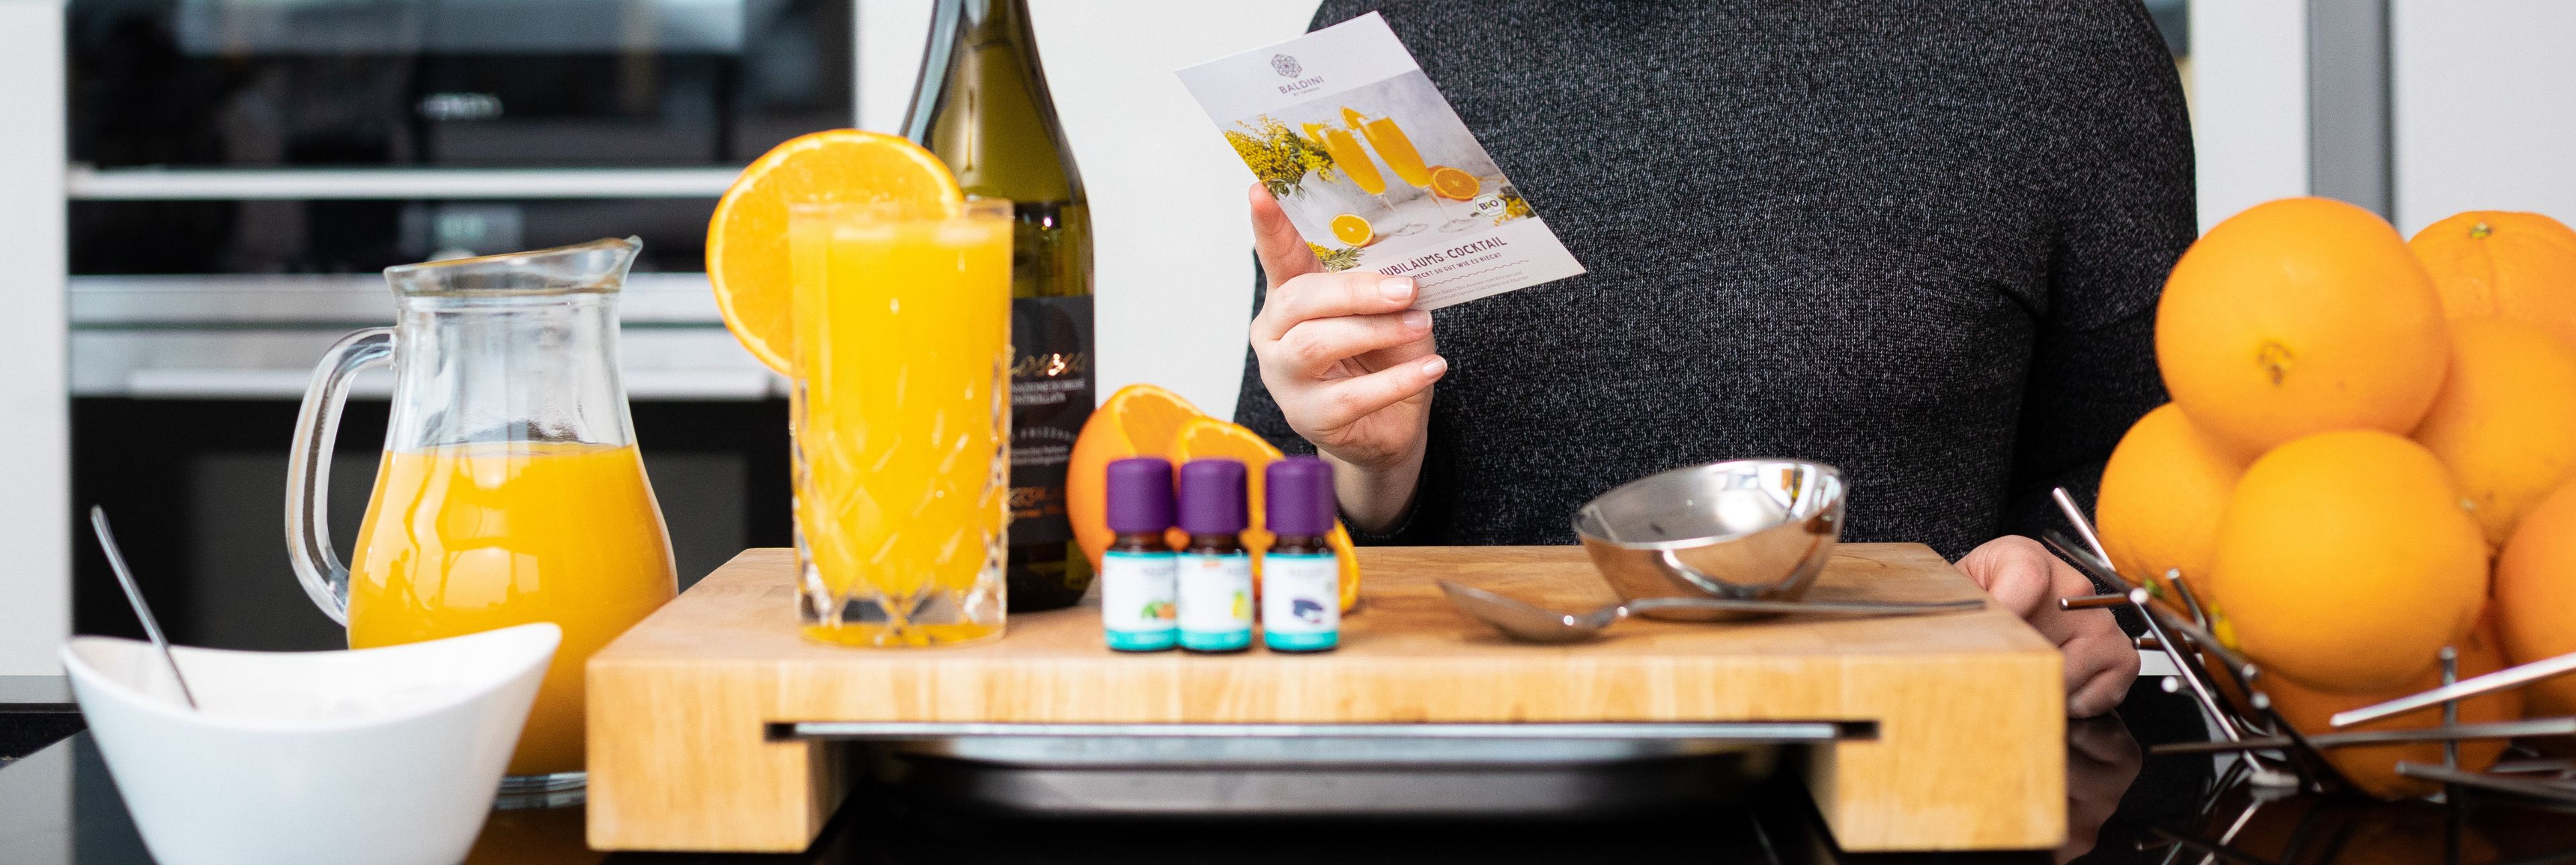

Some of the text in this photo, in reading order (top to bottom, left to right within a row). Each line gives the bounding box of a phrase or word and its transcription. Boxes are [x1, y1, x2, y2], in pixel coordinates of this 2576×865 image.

[1279, 75, 1324, 93] BALDINI
[1379, 236, 1507, 276] JUBILÄUMS-COCKTAIL
[1458, 260, 1470, 269] WIE
[1480, 252, 1502, 262] RIECHT
